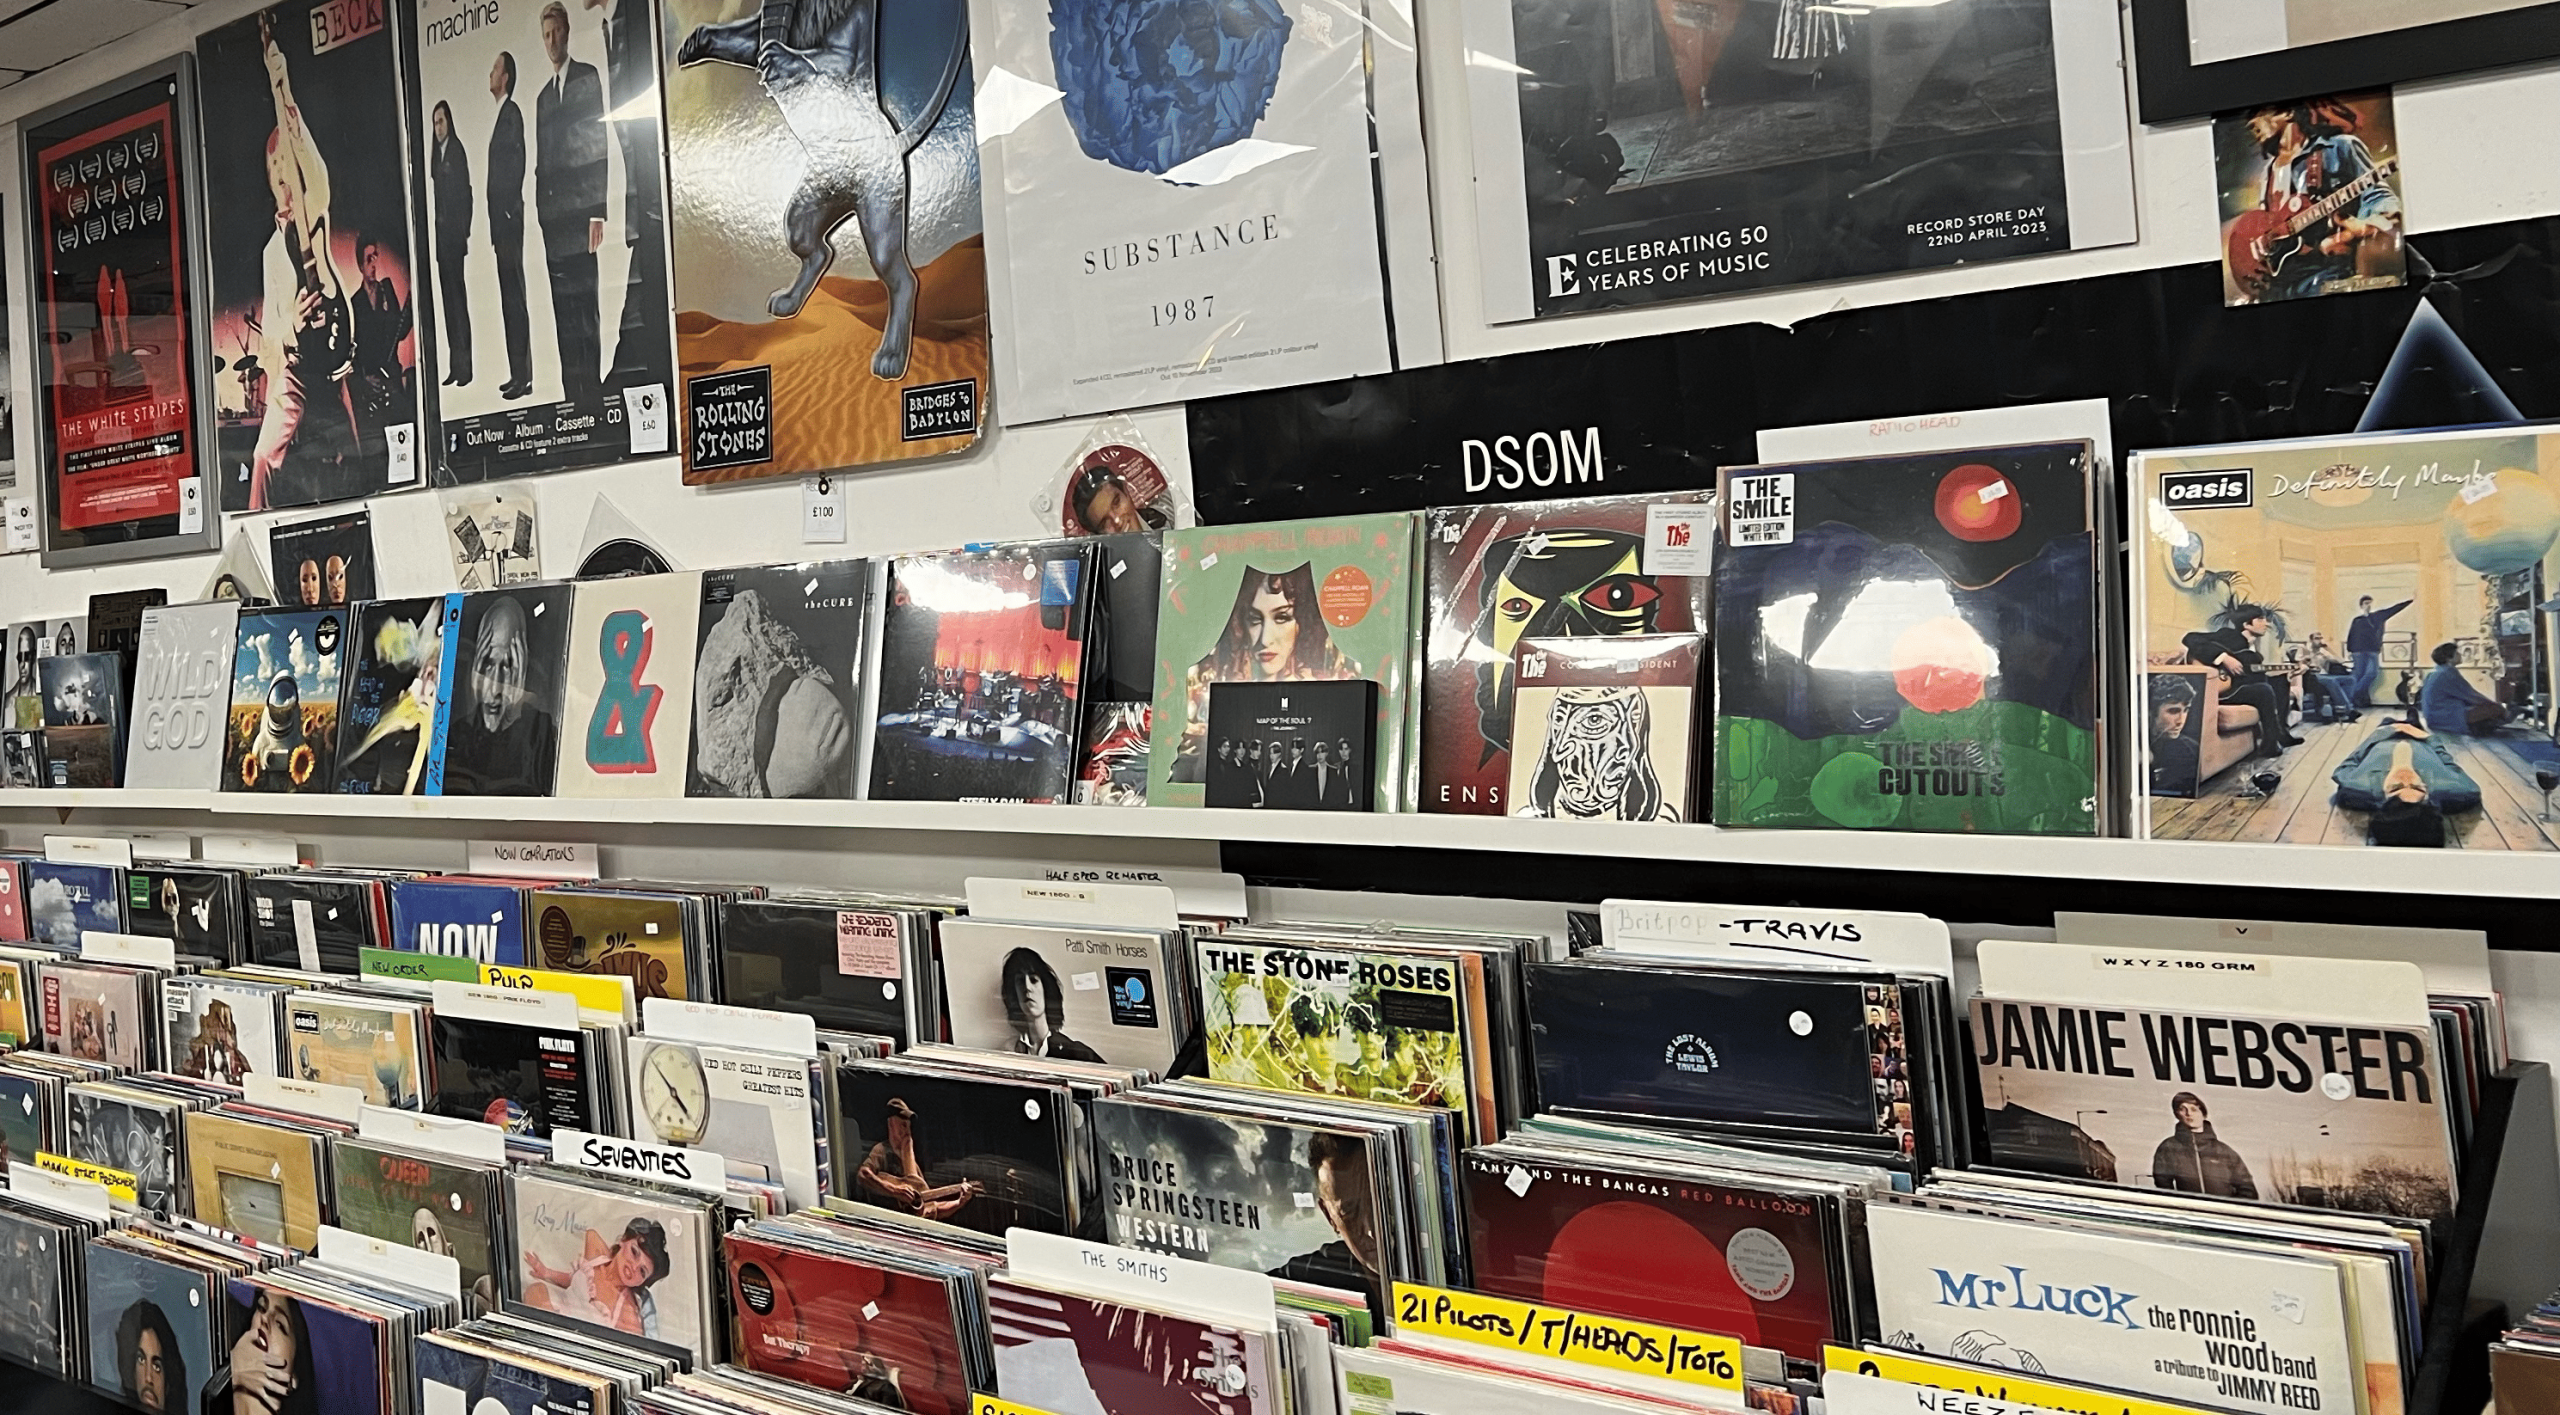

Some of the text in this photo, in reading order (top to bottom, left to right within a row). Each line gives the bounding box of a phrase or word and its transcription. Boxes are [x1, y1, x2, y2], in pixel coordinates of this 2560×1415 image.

[313, 0, 381, 48] BECK
[427, 2, 499, 47] machine
[1907, 205, 2046, 236] RECORD STORE DAY
[1927, 221, 2047, 248] 22ND APRIL 2023
[1084, 214, 1279, 275] SUBSTANCE
[1586, 225, 1769, 268] CELEBRATING 50
[1588, 250, 1770, 293] YEARS OF MUSIC
[1151, 295, 1214, 327] 1987
[719, 383, 737, 396] THE
[909, 391, 970, 412] BRIDGES TO
[62, 421, 83, 437] THE
[88, 411, 127, 432] WHITE
[133, 398, 184, 423] STRIPES
[466, 431, 484, 446] Out
[484, 428, 505, 443] Now
[515, 423, 544, 438] Album
[555, 414, 595, 432] Cassette
[607, 408, 622, 424] CD
[695, 396, 766, 429] ROLLING
[909, 408, 972, 431] BABYLON
[696, 426, 766, 461] STONES
[1461, 426, 1604, 492] DSOM
[1742, 477, 1781, 500] THE
[2168, 459, 2497, 501] oasis Definitely Maybe
[813, 506, 834, 518] £100
[1732, 496, 1792, 520] SMILE
[1666, 523, 1691, 547] The
[1739, 522, 1785, 533] LIMITED EDITION
[1743, 531, 1780, 542] WHITE VINYL
[146, 649, 224, 701] WILD
[142, 702, 211, 751] GOD
[1878, 768, 2006, 797] CUTOUTS
[494, 846, 575, 862] NOW COMPILATIONS
[1046, 869, 1069, 881] HALF
[1617, 908, 1708, 935] Britpop
[2235, 926, 2248, 935] V
[419, 923, 498, 965] NOW
[1065, 938, 1148, 959] Patti Smith Horses
[371, 960, 429, 977] NEW ORDER
[1206, 949, 1451, 992] THE STONE ROSES
[2102, 957, 2118, 966] W
[2122, 958, 2135, 966] X
[2174, 960, 2206, 970] 180
[2212, 961, 2256, 972] GRM
[295, 1015, 317, 1028] oasis
[1665, 1034, 1719, 1068] THE LOST ALBUM
[1677, 1053, 1705, 1064] LEWIS
[1976, 1001, 2433, 1104] JAMIE WEBSTER
[704, 1058, 803, 1081] RED HOT CHILI PEPPERS
[1675, 1062, 1709, 1073] TAYLOR
[742, 1080, 805, 1098] GREATEST HITS
[42, 1160, 70, 1176] MANIC
[380, 1156, 431, 1187] QUEEN
[579, 1138, 692, 1181] SEVENTIES
[1109, 1152, 1177, 1188] BRUCE
[1470, 1161, 1511, 1175] TANK
[1562, 1173, 1593, 1187] THE
[1602, 1178, 1670, 1197] BANGAS
[1681, 1189, 1713, 1203] RED
[1725, 1195, 1812, 1216] BALLOON
[1112, 1182, 1260, 1231] SPRINGSTEEN
[1115, 1213, 1210, 1254] WESTERN
[1080, 1249, 1107, 1269] THE
[1117, 1258, 1168, 1284] SMITHS
[1401, 1294, 1429, 1325] 21
[1929, 1264, 2145, 1331] Mr Luck
[2147, 1304, 2256, 1342] the ronnie
[1211, 1347, 1243, 1367] The
[2207, 1340, 2317, 1382] wood band
[2154, 1360, 2321, 1412] a tribute to JIMMY REED
